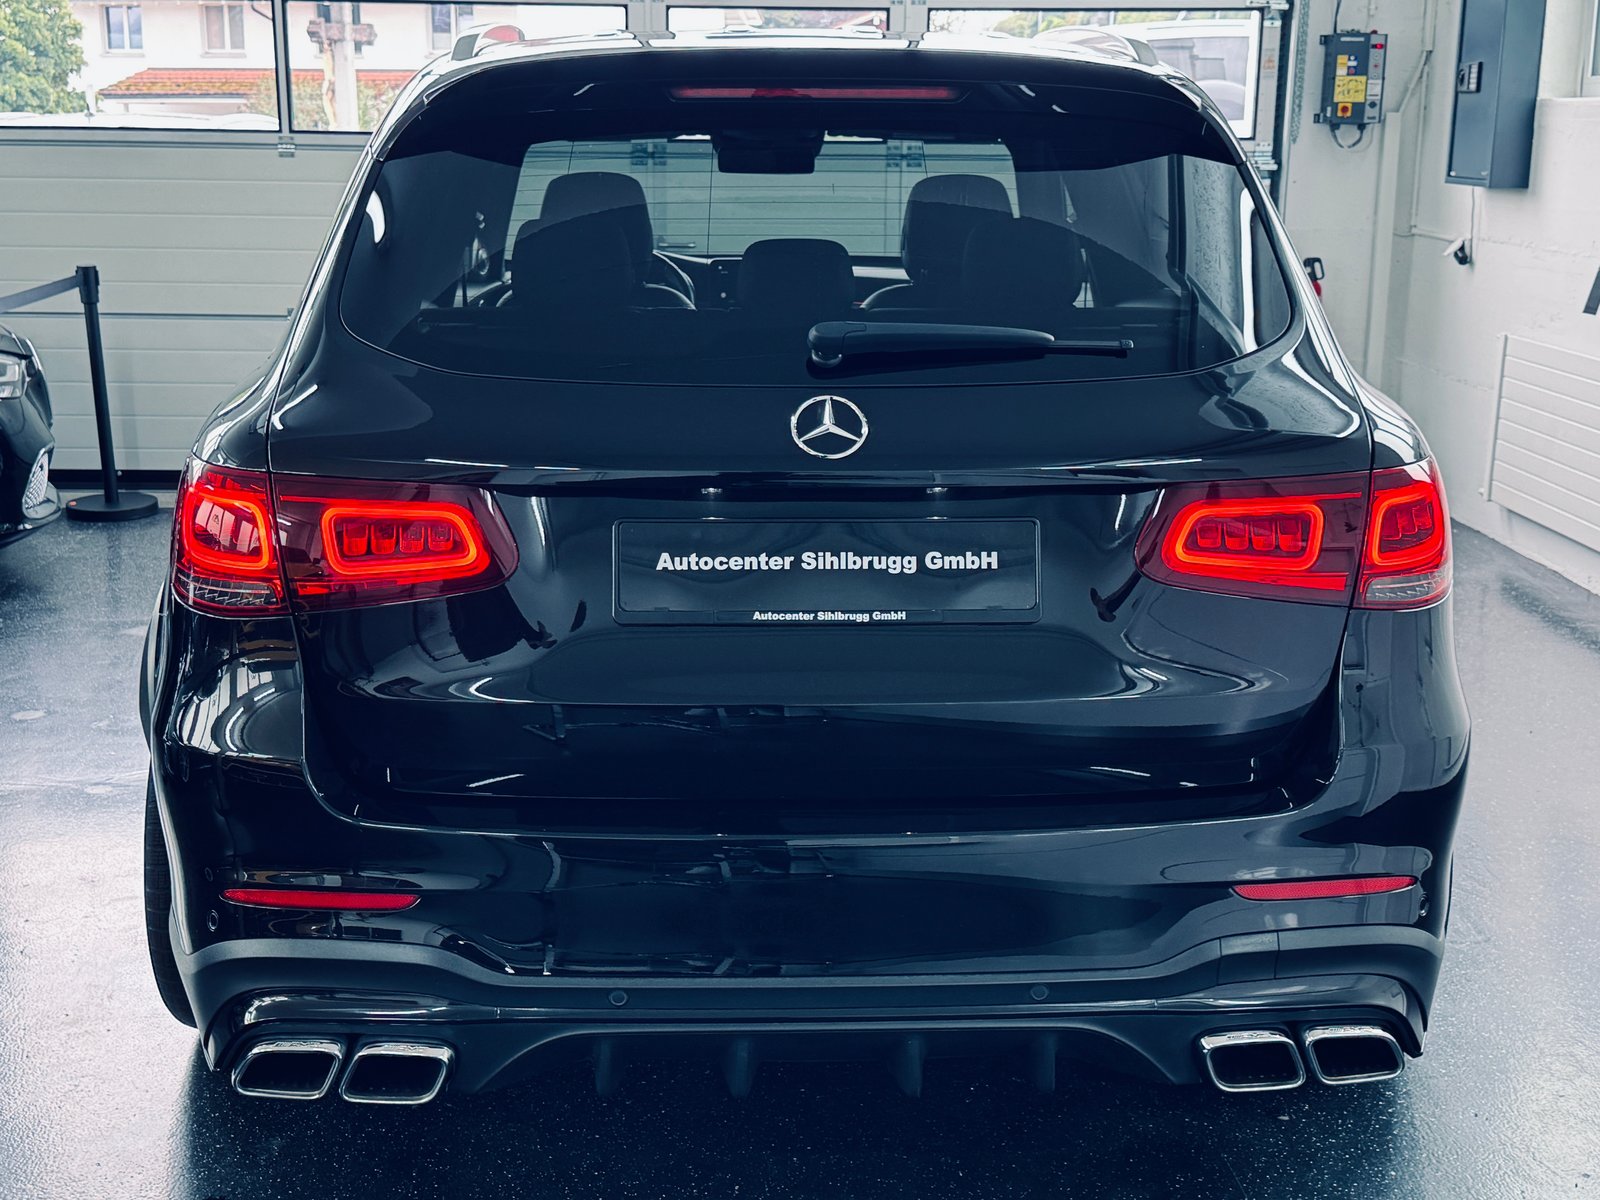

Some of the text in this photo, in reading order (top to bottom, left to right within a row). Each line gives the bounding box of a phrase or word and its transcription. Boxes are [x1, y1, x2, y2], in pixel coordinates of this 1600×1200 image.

[655, 551, 998, 574] Autocenter Sihlbrugg GmbH
[752, 610, 906, 623] Autocenter Sihlbrugg GmbH
